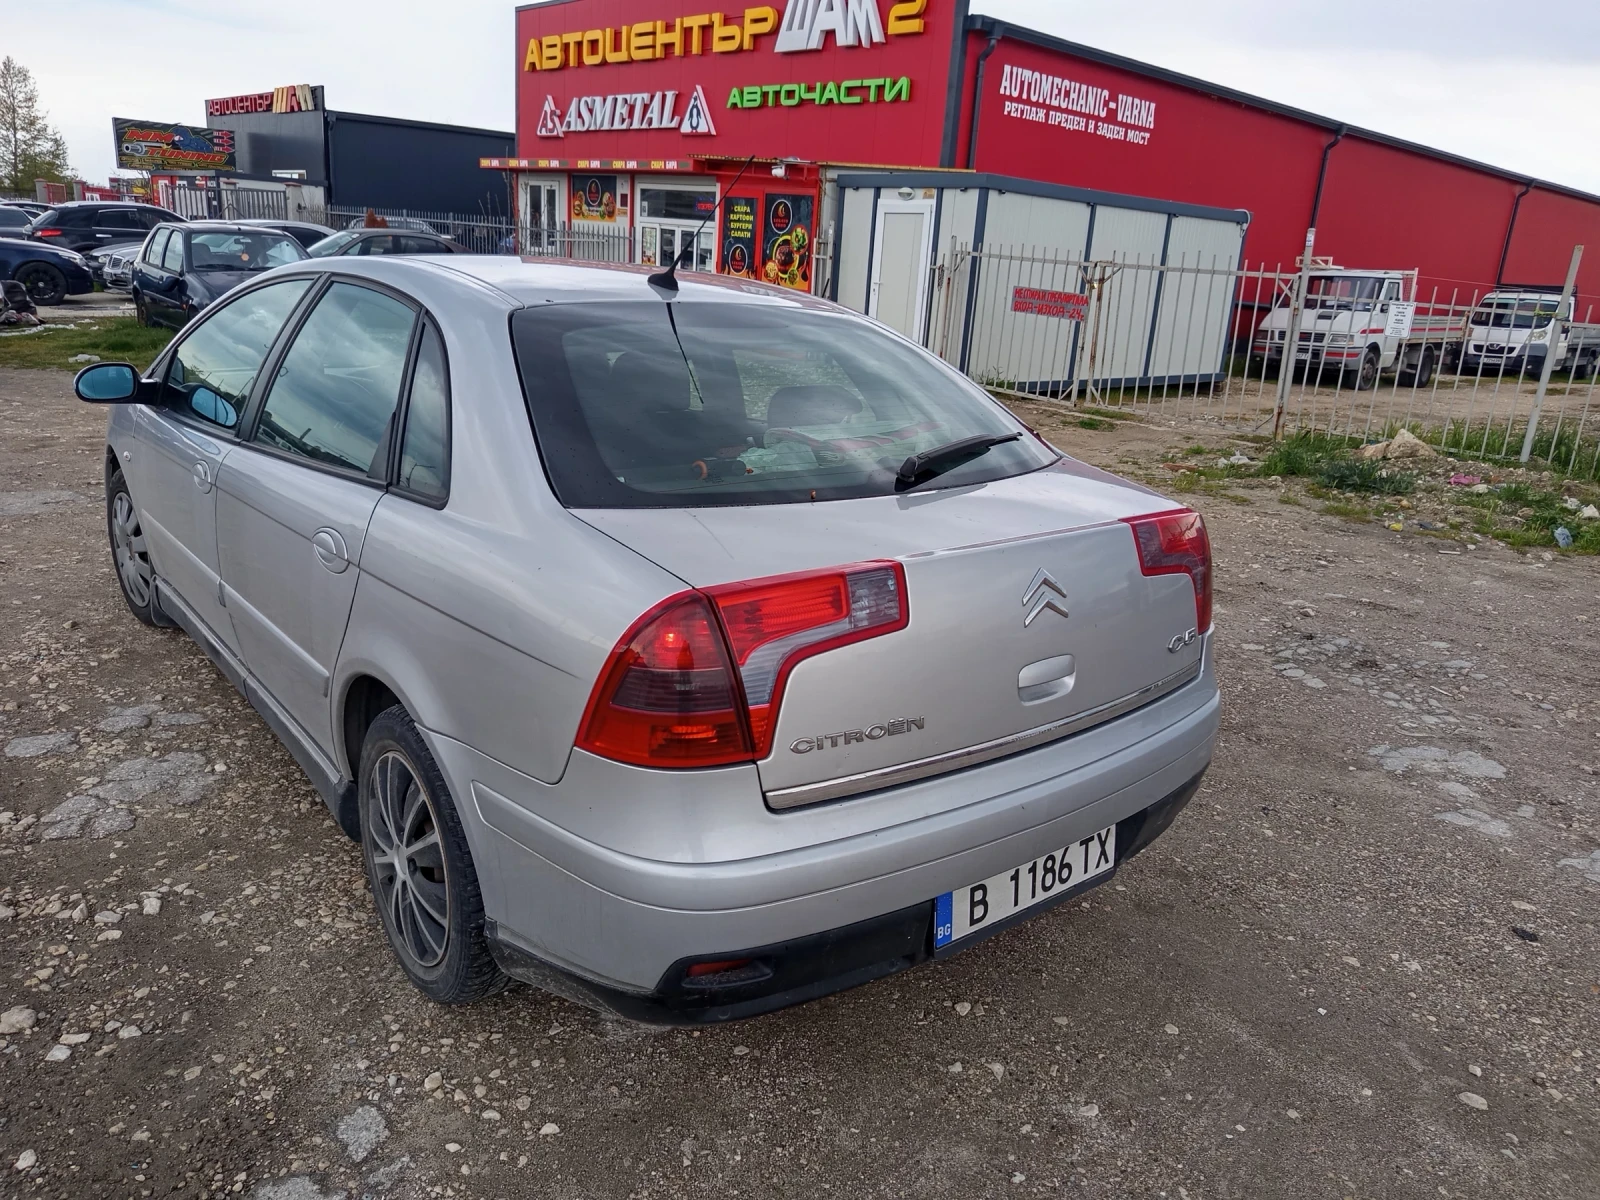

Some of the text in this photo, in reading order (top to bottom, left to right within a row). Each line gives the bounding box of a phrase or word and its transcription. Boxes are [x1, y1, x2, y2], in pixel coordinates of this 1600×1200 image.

[524, 0, 927, 72] АВТОЦЕНТЪР ШАМ 2
[208, 84, 315, 117] АВТОЦЕНТЪР ШАМ
[726, 76, 911, 109] АВТОЧАСТИ
[561, 91, 681, 133] ASMETAL
[1004, 101, 1150, 145] РЕГЛАЖ ПРЕДЕН И ЗАДЕН МОСТ
[124, 129, 175, 143] MM
[147, 147, 226, 162] TUNING
[730, 222, 752, 230] БУРГЕРИ
[731, 230, 751, 238] САЛАТИ
[1167, 627, 1196, 654] C5
[789, 715, 925, 754] CITROËN
[969, 828, 1111, 927] B 1186 TX
[937, 923, 951, 939] BG
